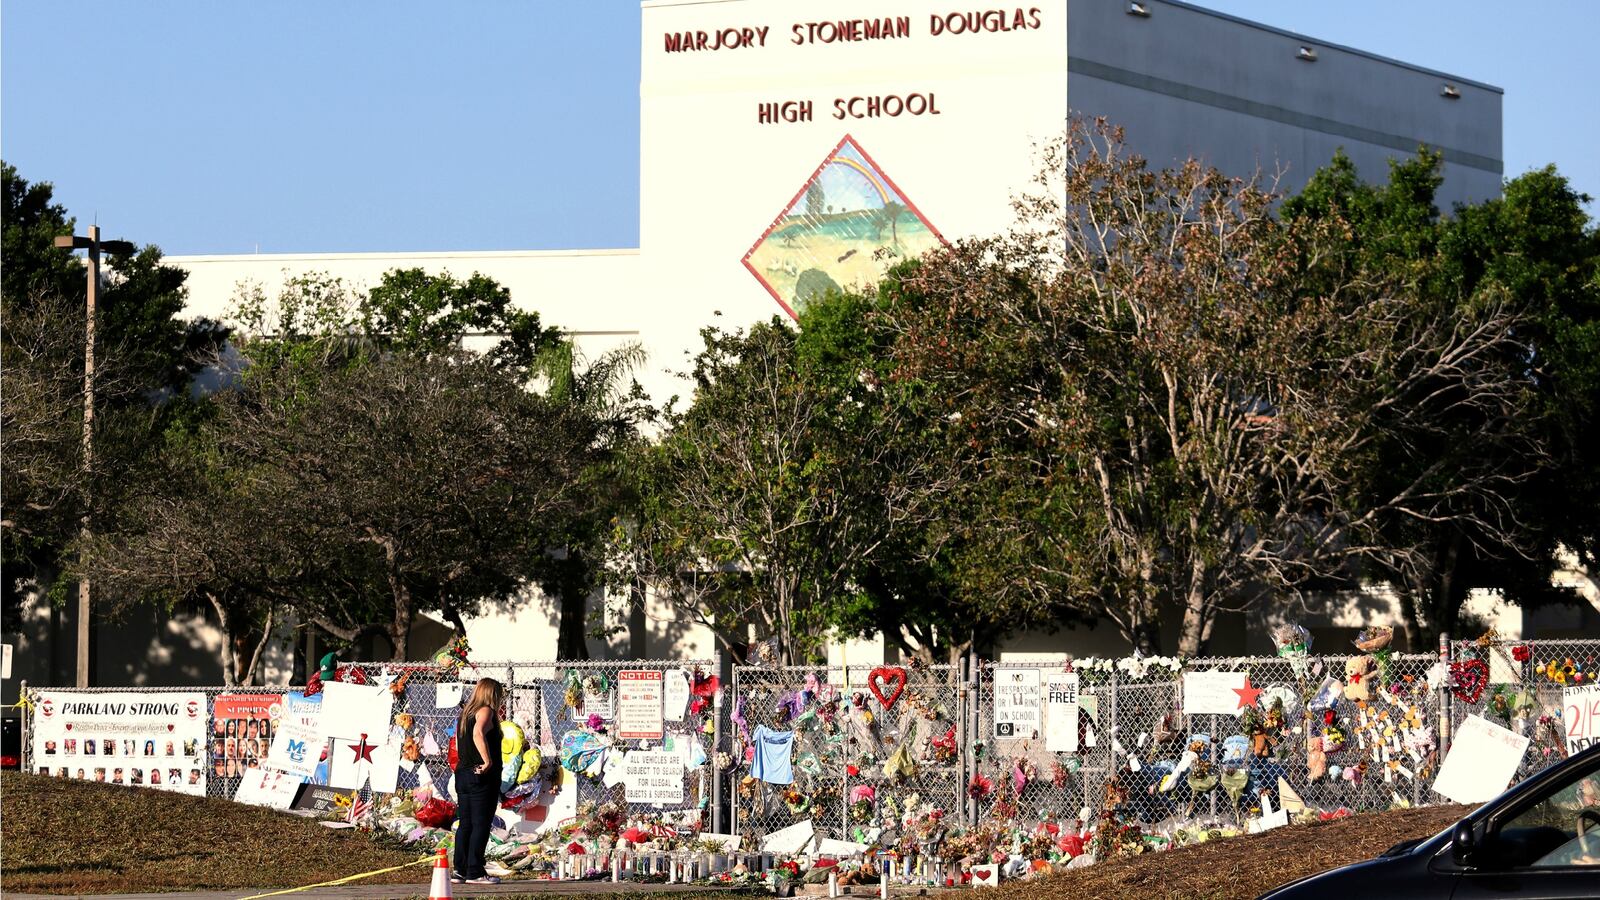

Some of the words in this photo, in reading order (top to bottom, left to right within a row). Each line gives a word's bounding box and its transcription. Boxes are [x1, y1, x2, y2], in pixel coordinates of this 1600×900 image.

[664, 25, 769, 53] MARJORY
[791, 15, 910, 45] STONEMAN
[930, 6, 1041, 36] DOUGLAS
[758, 100, 812, 124] HIGH
[832, 92, 940, 120] SCHOOL
[1012, 673, 1024, 682] NO
[998, 686, 1038, 695] TRESPASSING
[1049, 691, 1075, 704] FREE
[62, 703, 126, 715] PARKLAND
[129, 703, 179, 715] STRONG
[1000, 712, 1009, 720] ON
[1011, 712, 1035, 720] SCHOOL
[630, 756, 640, 764] ALL
[642, 756, 667, 764] VEHICLES
[670, 756, 680, 764] ARE
[626, 767, 650, 775] SUBJECT
[653, 767, 660, 775] TO
[662, 767, 683, 775] SEARCH
[638, 778, 649, 787] FOR
[651, 779, 671, 787] ILLEGAL
[627, 790, 647, 798] OBJECTS
[654, 790, 682, 799] SUBSTANCES
